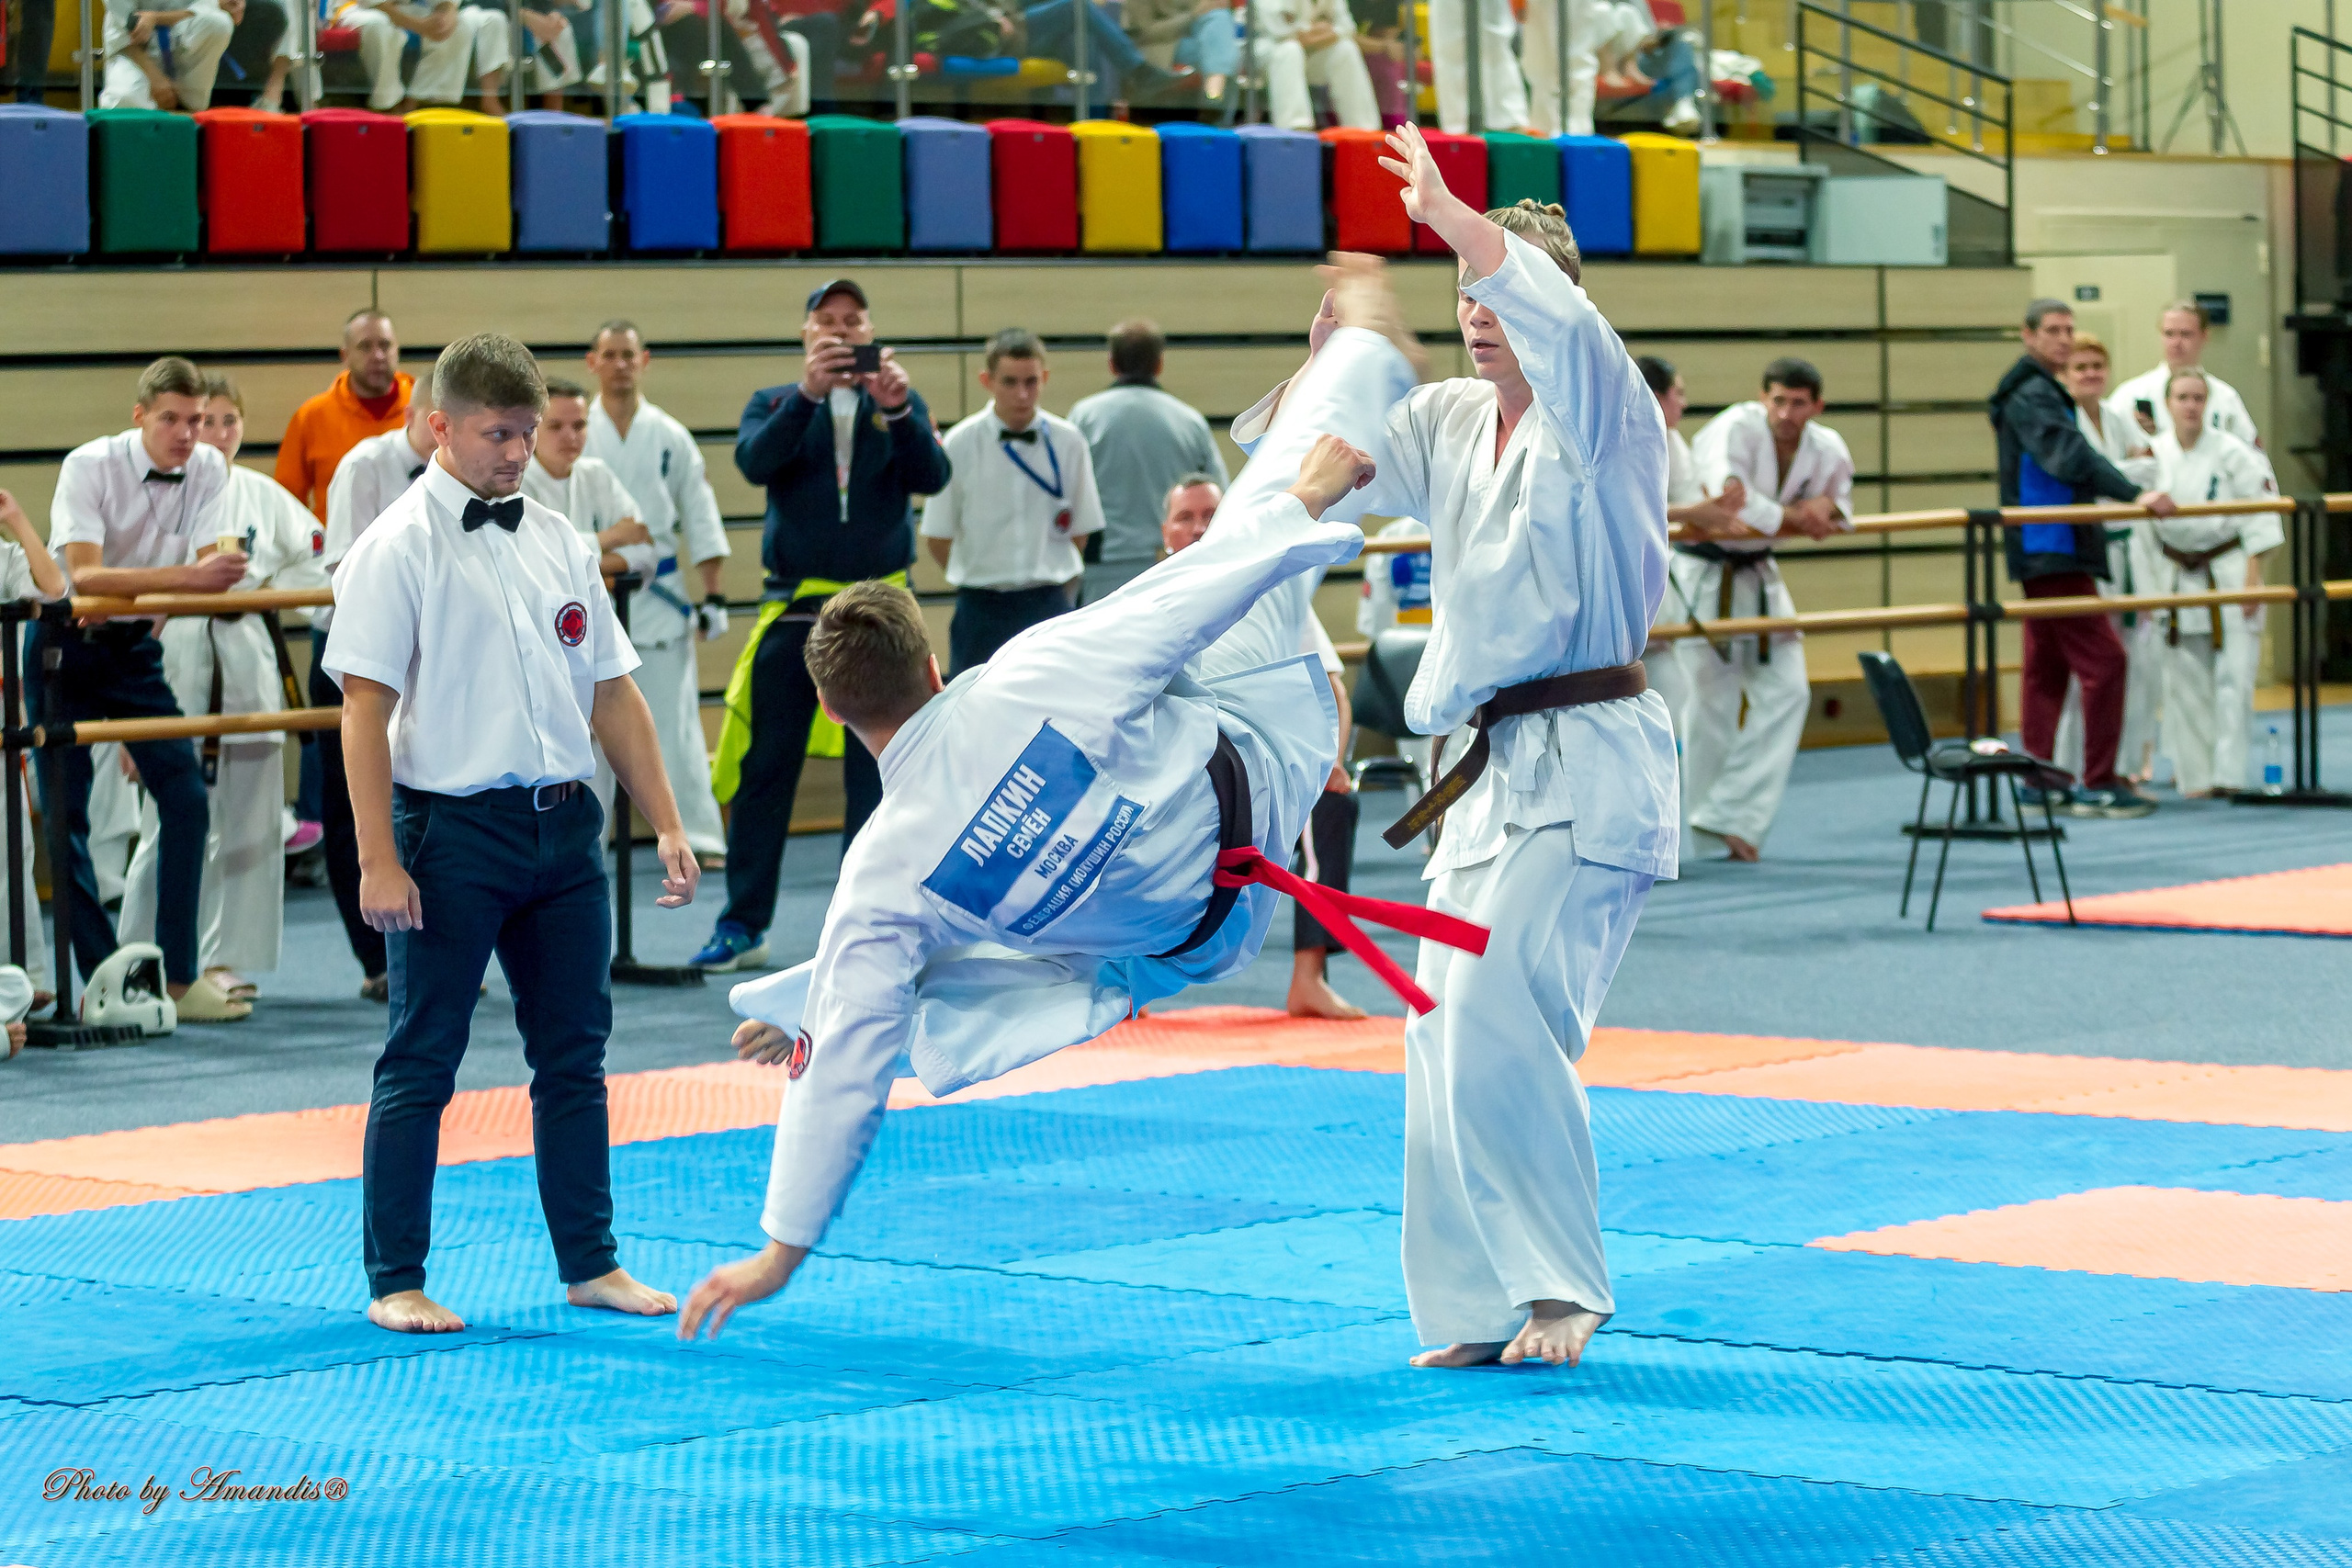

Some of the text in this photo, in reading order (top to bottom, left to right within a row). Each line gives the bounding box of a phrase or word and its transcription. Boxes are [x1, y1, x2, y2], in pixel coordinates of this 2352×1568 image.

[960, 762, 1046, 868] ЛАПКИН
[1006, 807, 1052, 859] СЕМЁН
[1023, 884, 1074, 930] ФЕДЕРАЦИЯ
[1105, 804, 1135, 843] РОССИИ
[1035, 834, 1079, 879] МОСКВА
